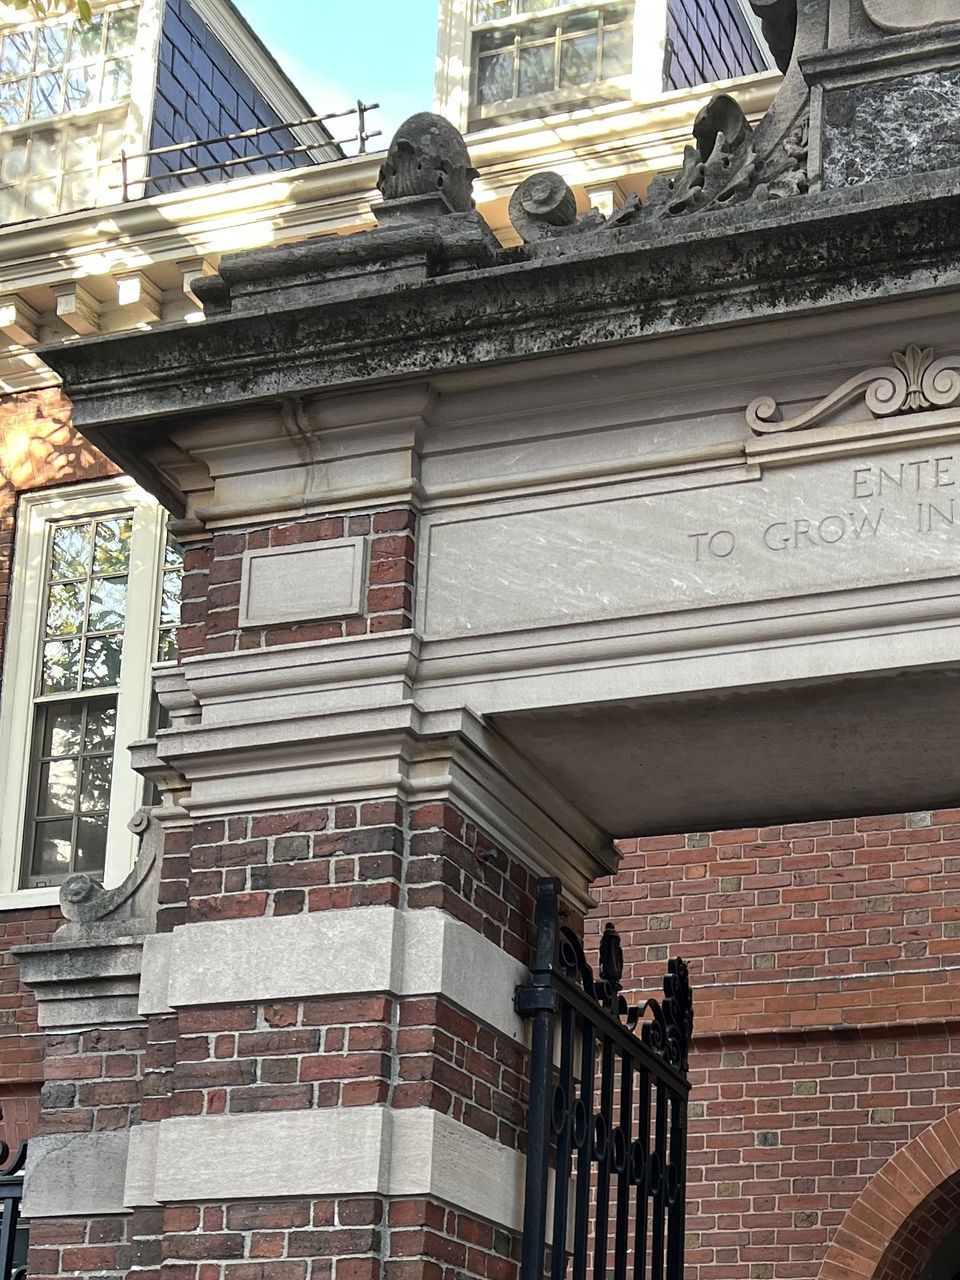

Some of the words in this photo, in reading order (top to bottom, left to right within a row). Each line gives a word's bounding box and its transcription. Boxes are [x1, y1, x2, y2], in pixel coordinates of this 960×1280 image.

[688, 529, 736, 562] TO
[763, 507, 885, 552] GROW
[915, 498, 955, 533] IN
